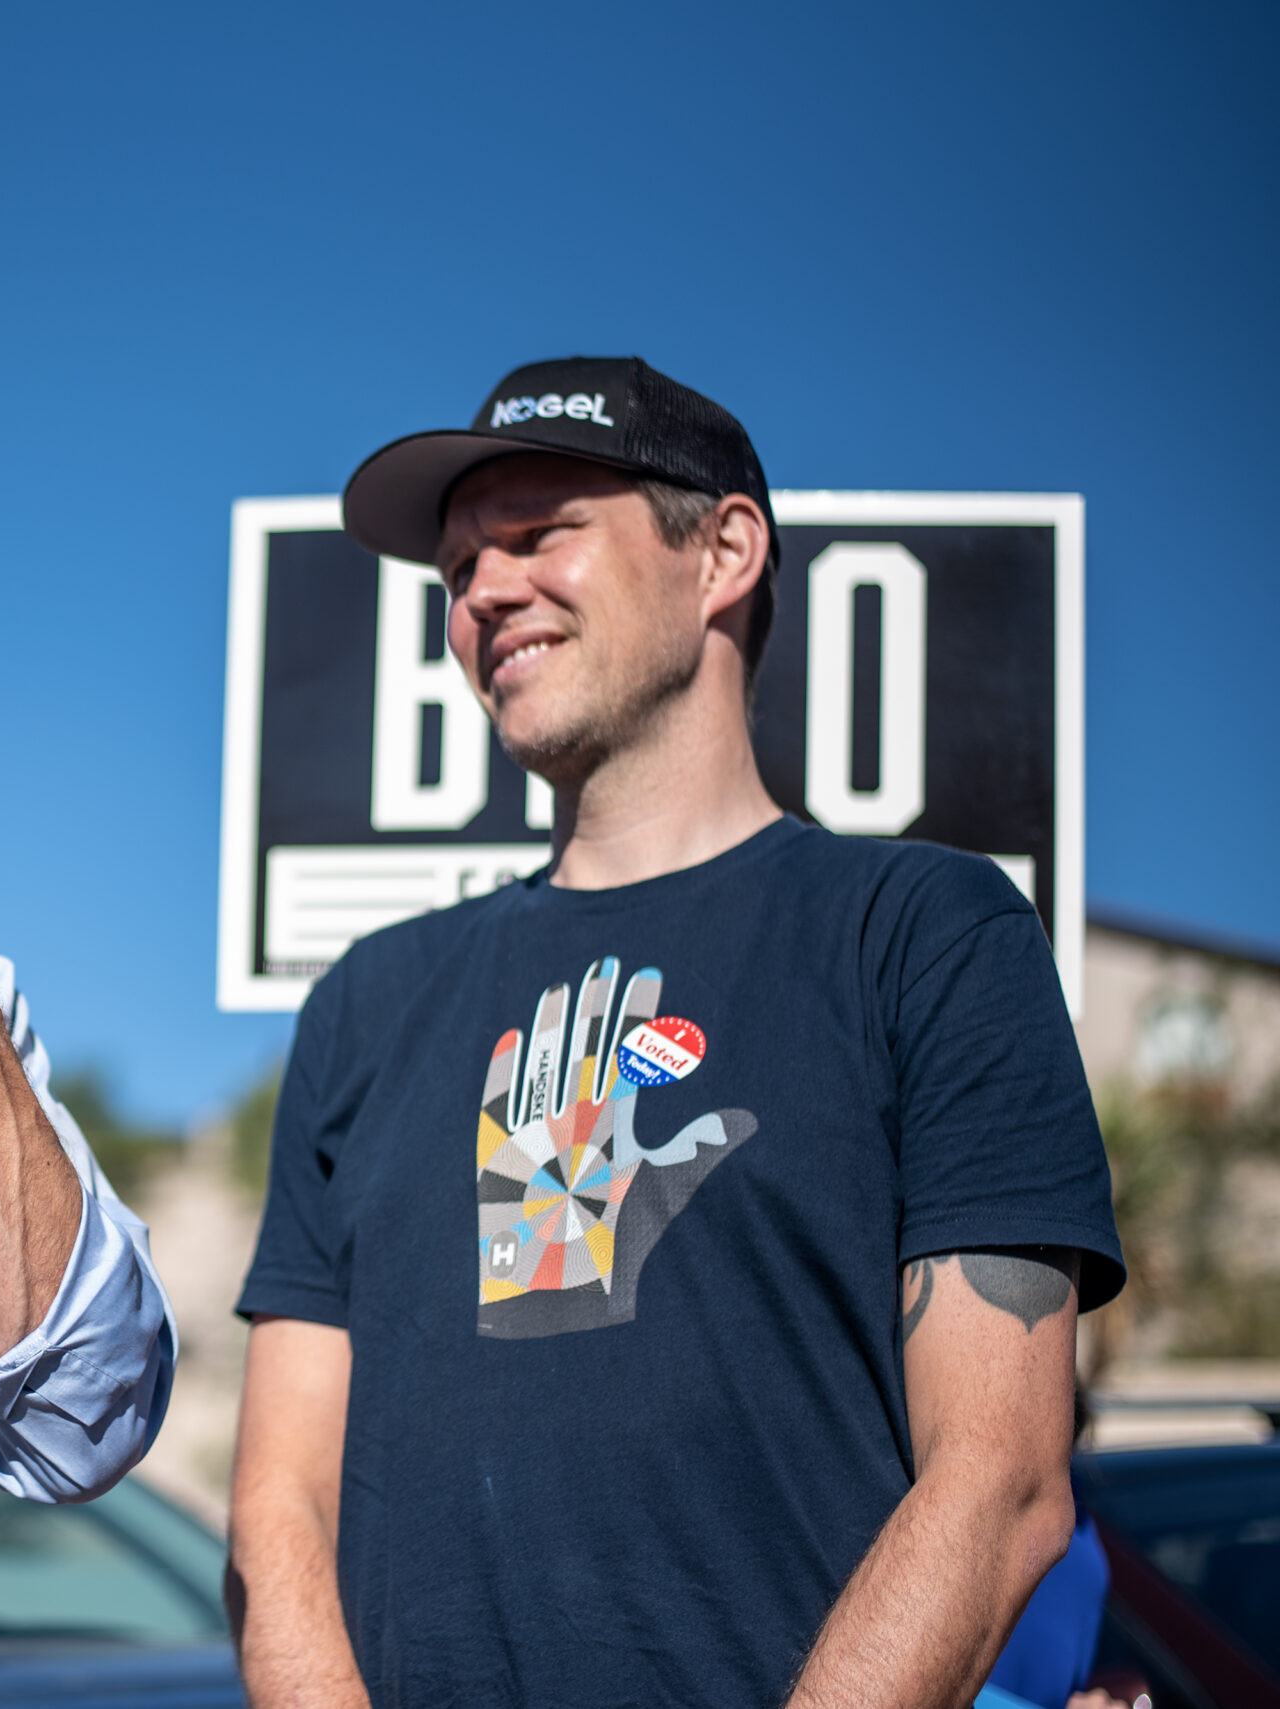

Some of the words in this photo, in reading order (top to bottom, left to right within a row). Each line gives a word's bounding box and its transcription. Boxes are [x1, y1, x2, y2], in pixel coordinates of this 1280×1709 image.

[371, 541, 926, 836] BO
[674, 1029, 686, 1041] I
[627, 1055, 661, 1080] Today!
[637, 1033, 688, 1071] Voted
[532, 1049, 551, 1121] HANDSKE
[492, 1243, 515, 1266] H
